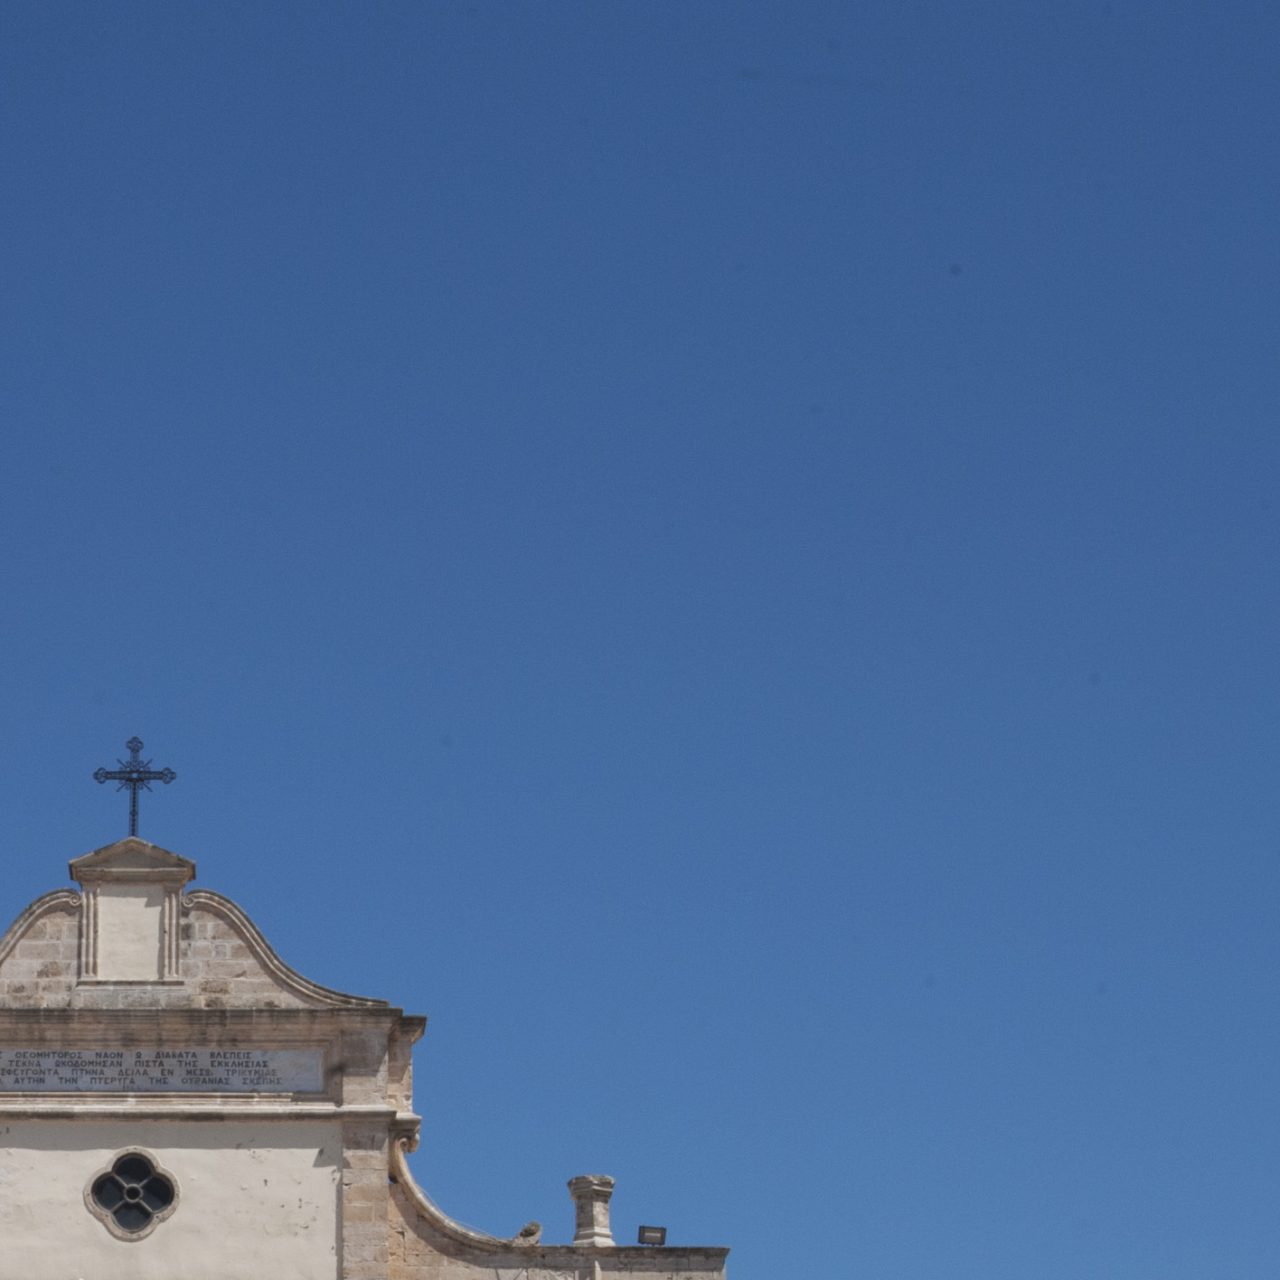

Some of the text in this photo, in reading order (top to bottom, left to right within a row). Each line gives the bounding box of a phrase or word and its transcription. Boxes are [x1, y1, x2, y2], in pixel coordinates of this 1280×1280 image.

[95, 1051, 123, 1059] ΝΑΟΝ
[176, 1060, 198, 1068] ΤΗΣ
[160, 1068, 174, 1076] ΕΝ
[148, 1077, 168, 1085] ΤΗΣ
